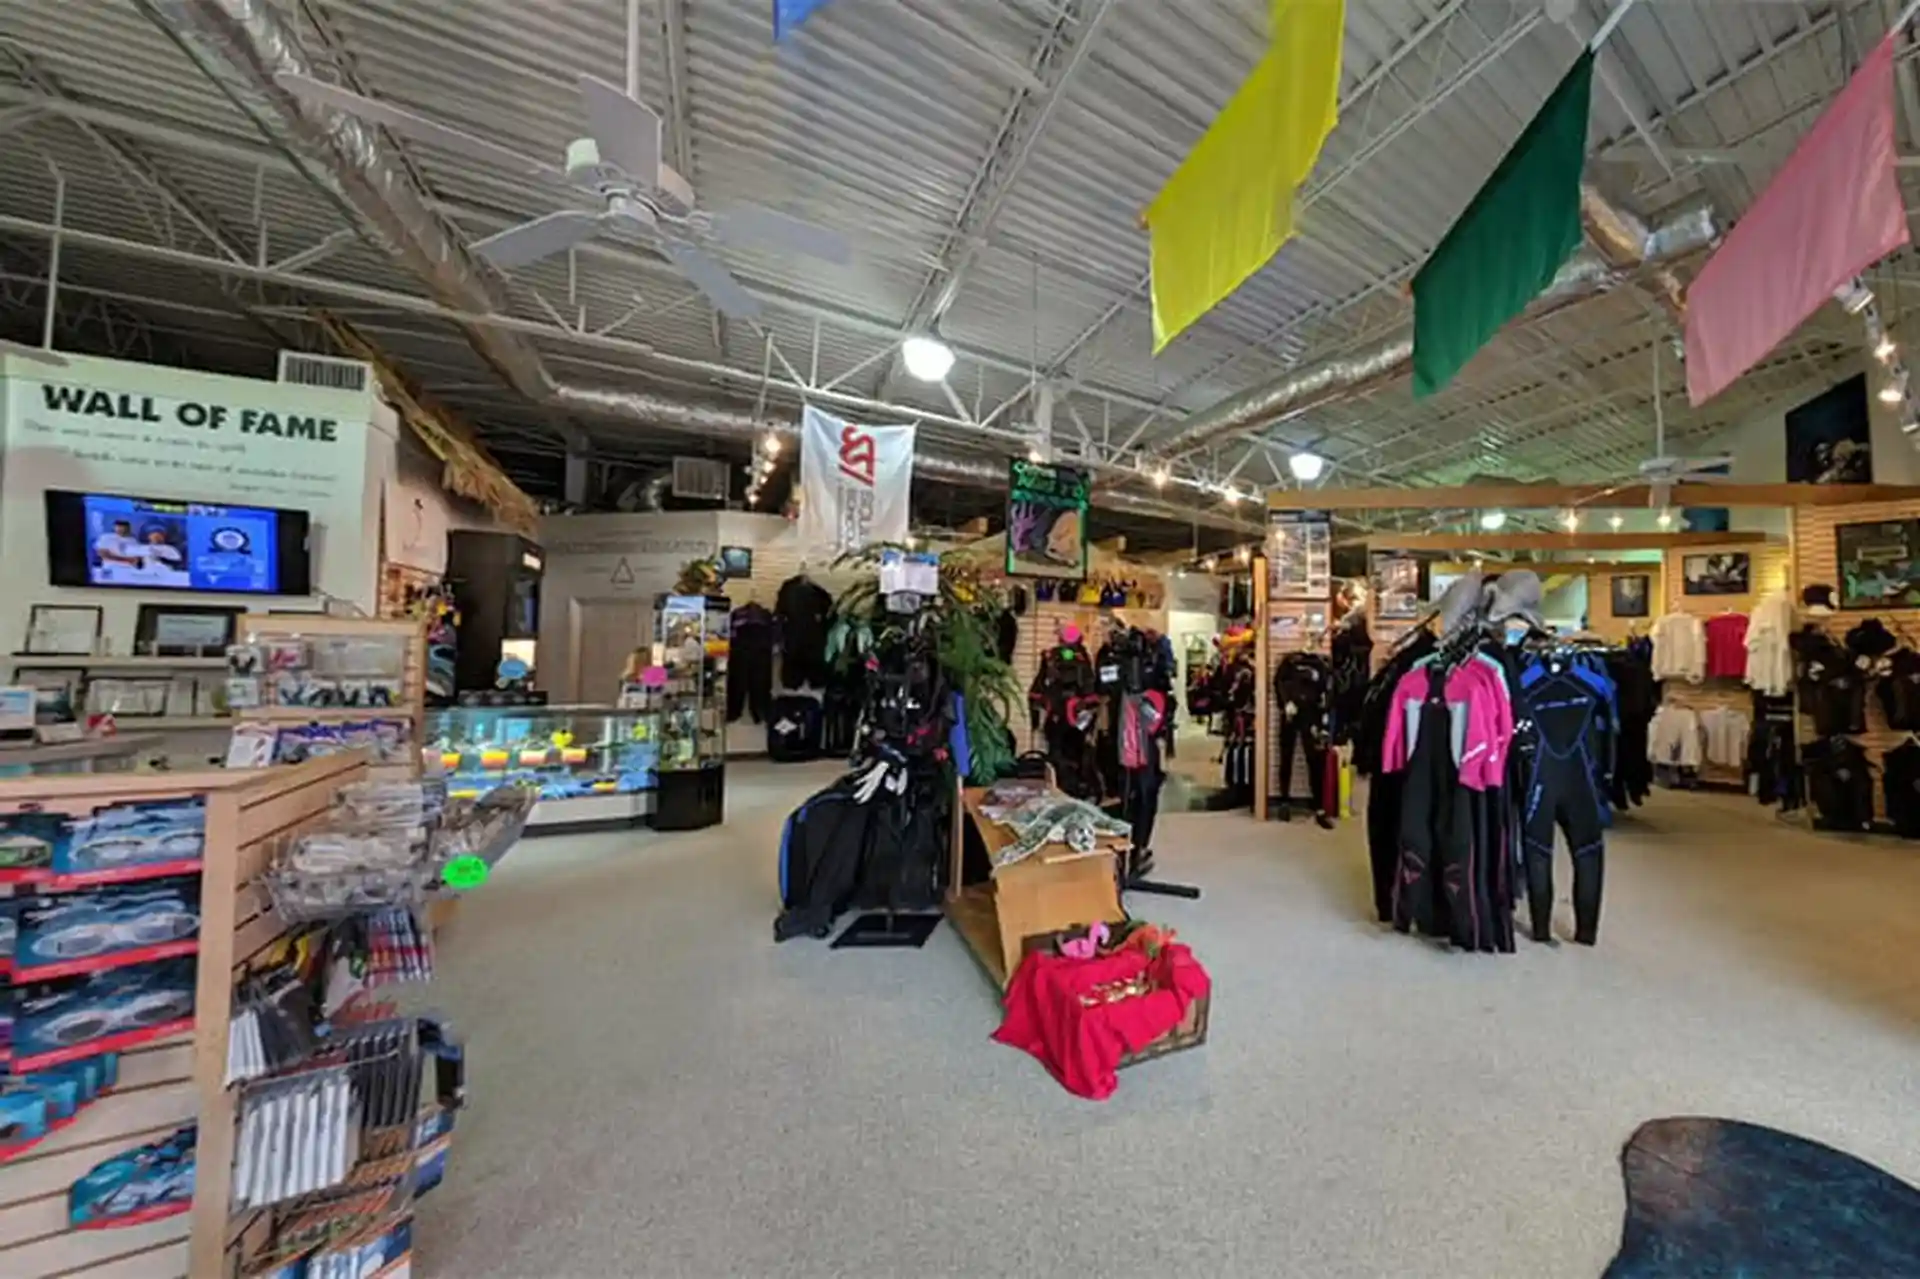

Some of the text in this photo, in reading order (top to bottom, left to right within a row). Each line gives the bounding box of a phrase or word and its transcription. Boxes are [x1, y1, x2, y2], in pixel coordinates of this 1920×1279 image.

[42, 384, 161, 423] WALL
[176, 402, 228, 430] OF
[240, 409, 338, 442] FAME
